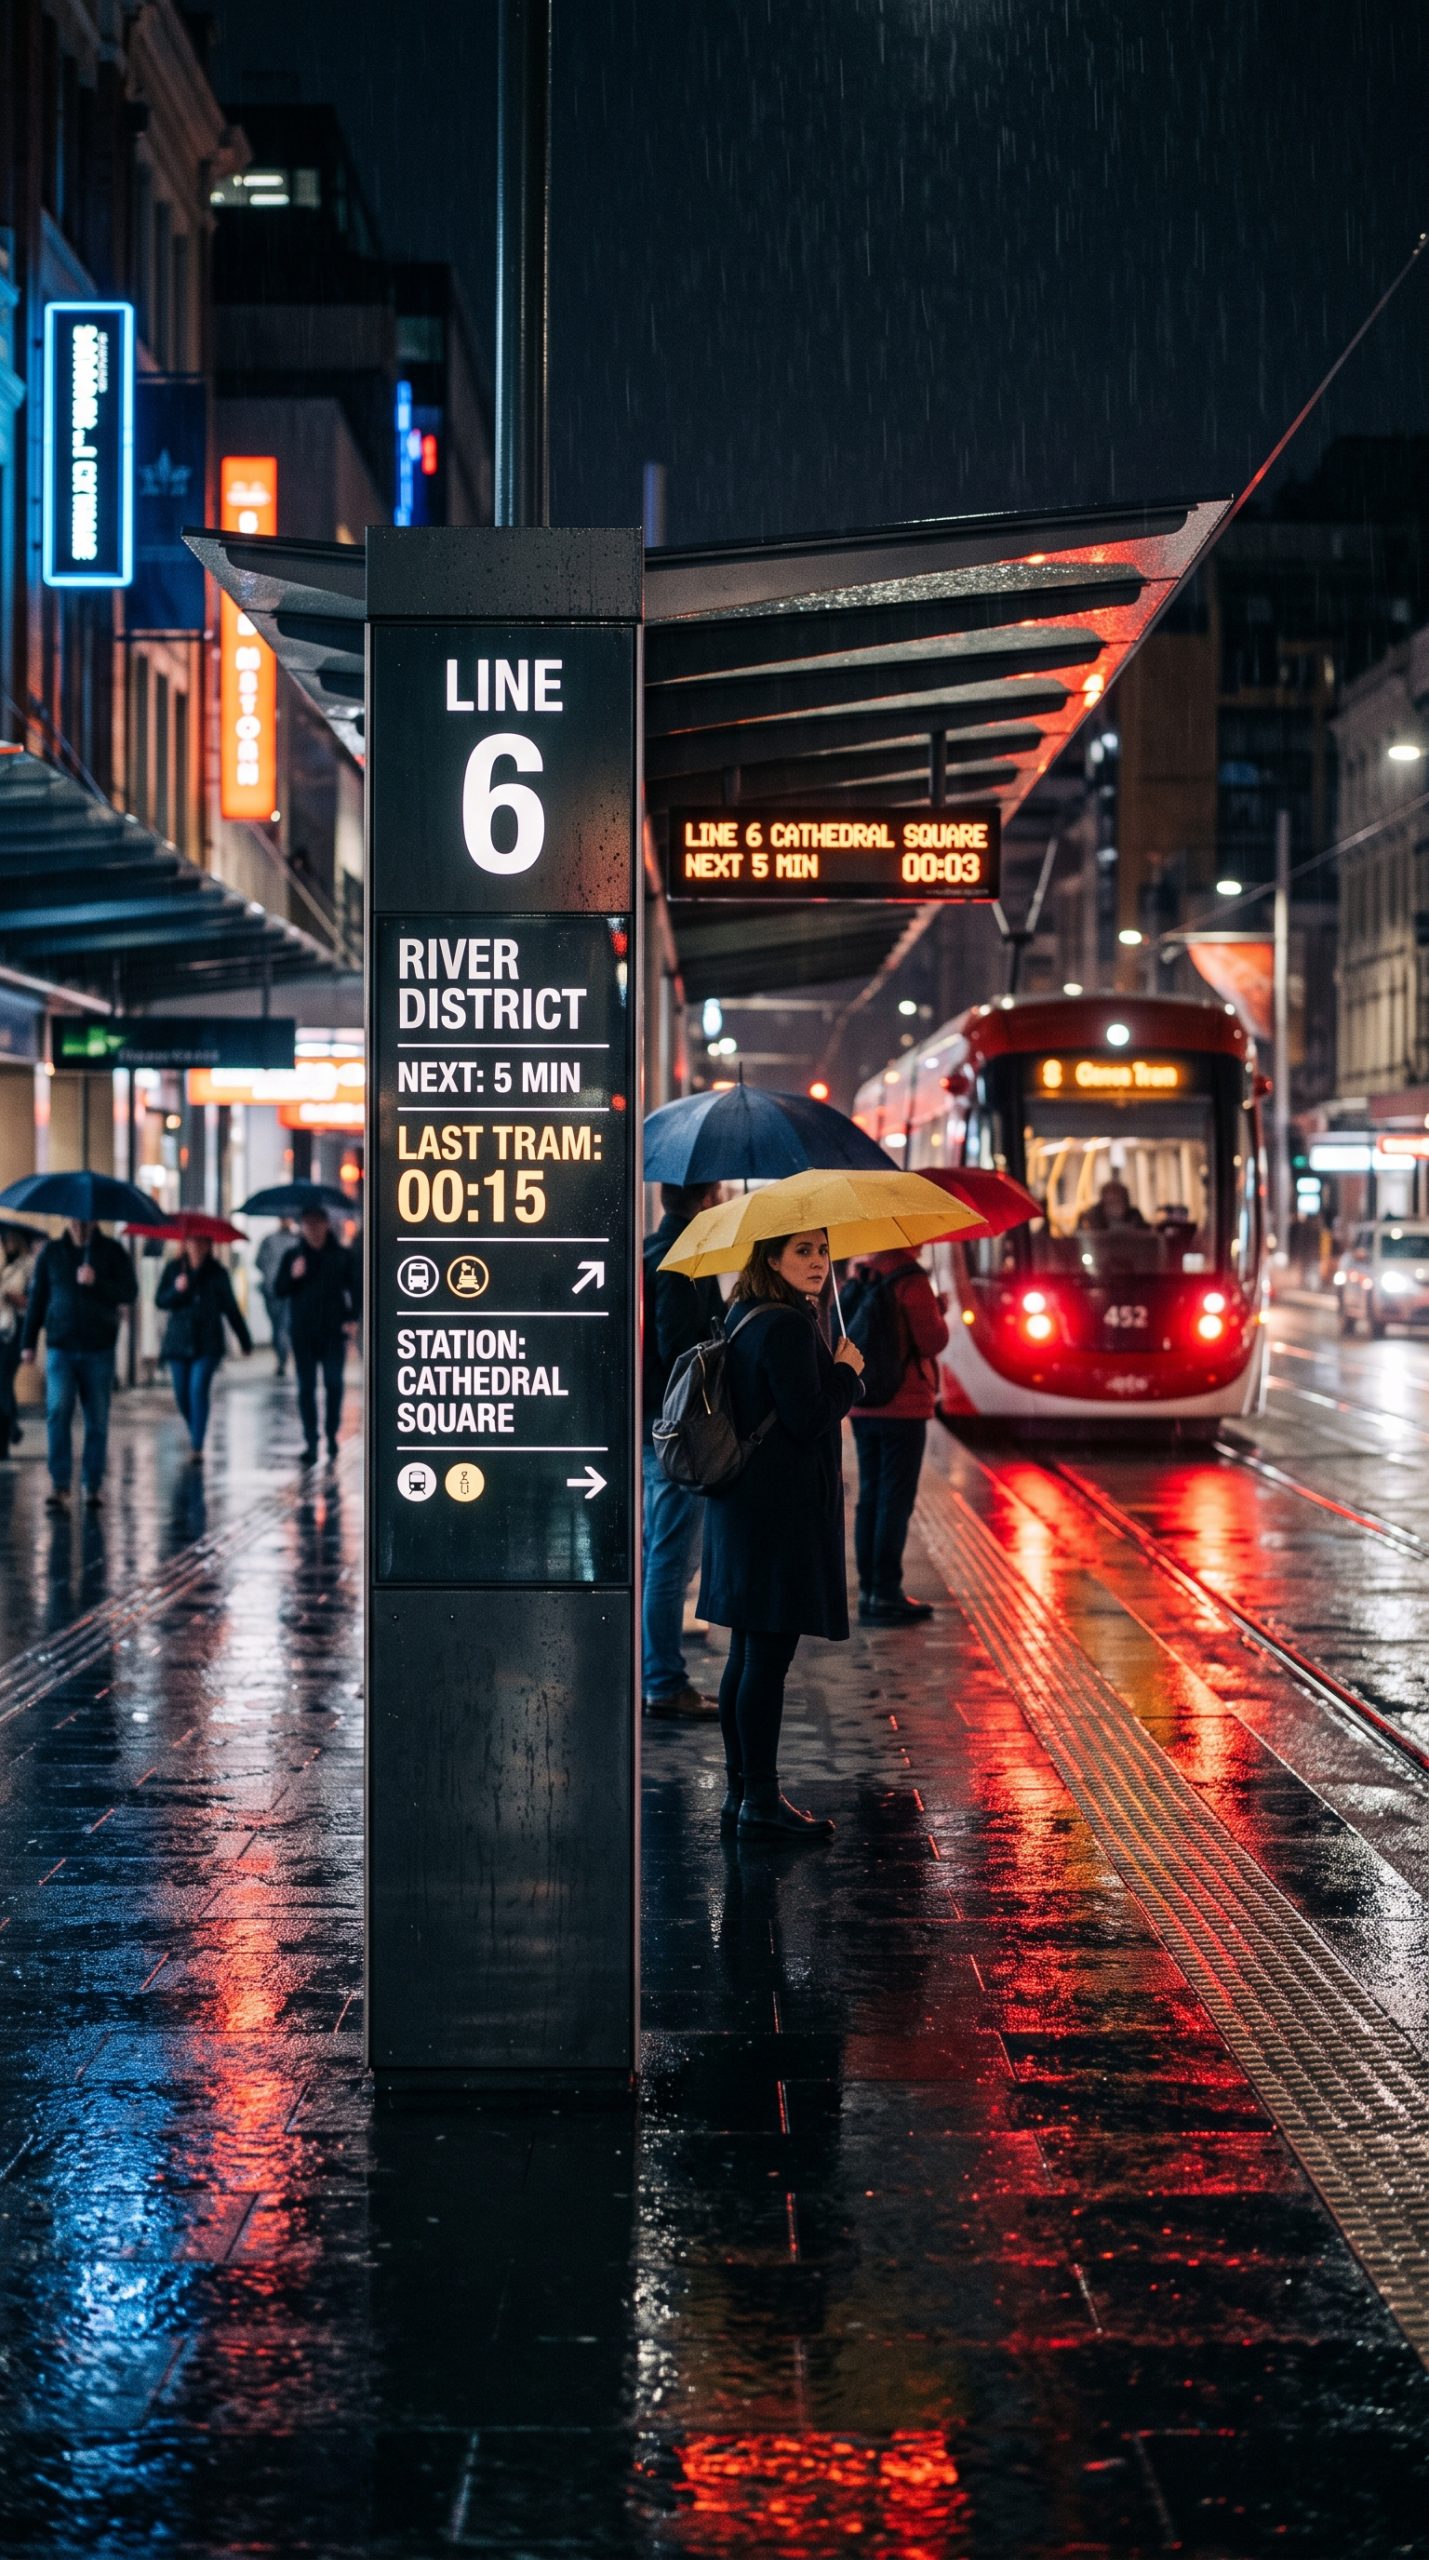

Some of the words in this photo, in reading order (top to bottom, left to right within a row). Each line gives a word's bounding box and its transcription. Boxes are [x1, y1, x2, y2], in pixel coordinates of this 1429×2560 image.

[447, 659, 563, 711] LINE
[463, 733, 544, 874] 6
[686, 823, 738, 847] LINE
[746, 823, 762, 847] 6
[771, 823, 895, 848] CATHEDRAL
[904, 824, 987, 848] SQUARE
[686, 853, 743, 877] NEXT
[752, 853, 768, 877] 5
[776, 854, 818, 878] MIN
[902, 853, 979, 882] 00:03
[400, 939, 519, 979] RIVER
[400, 988, 587, 1029] DISTRICT
[399, 1062, 483, 1092] NEXT:
[494, 1063, 512, 1093] 5
[523, 1062, 581, 1093] MIN
[399, 1126, 483, 1160] LAST
[493, 1126, 601, 1160] TRAM:
[398, 1169, 545, 1223] 00:15
[1103, 1305, 1149, 1328] 452
[398, 1329, 525, 1359] STATION:
[398, 1366, 568, 1395] CATHEDRAL
[398, 1403, 514, 1435] SQUARE
